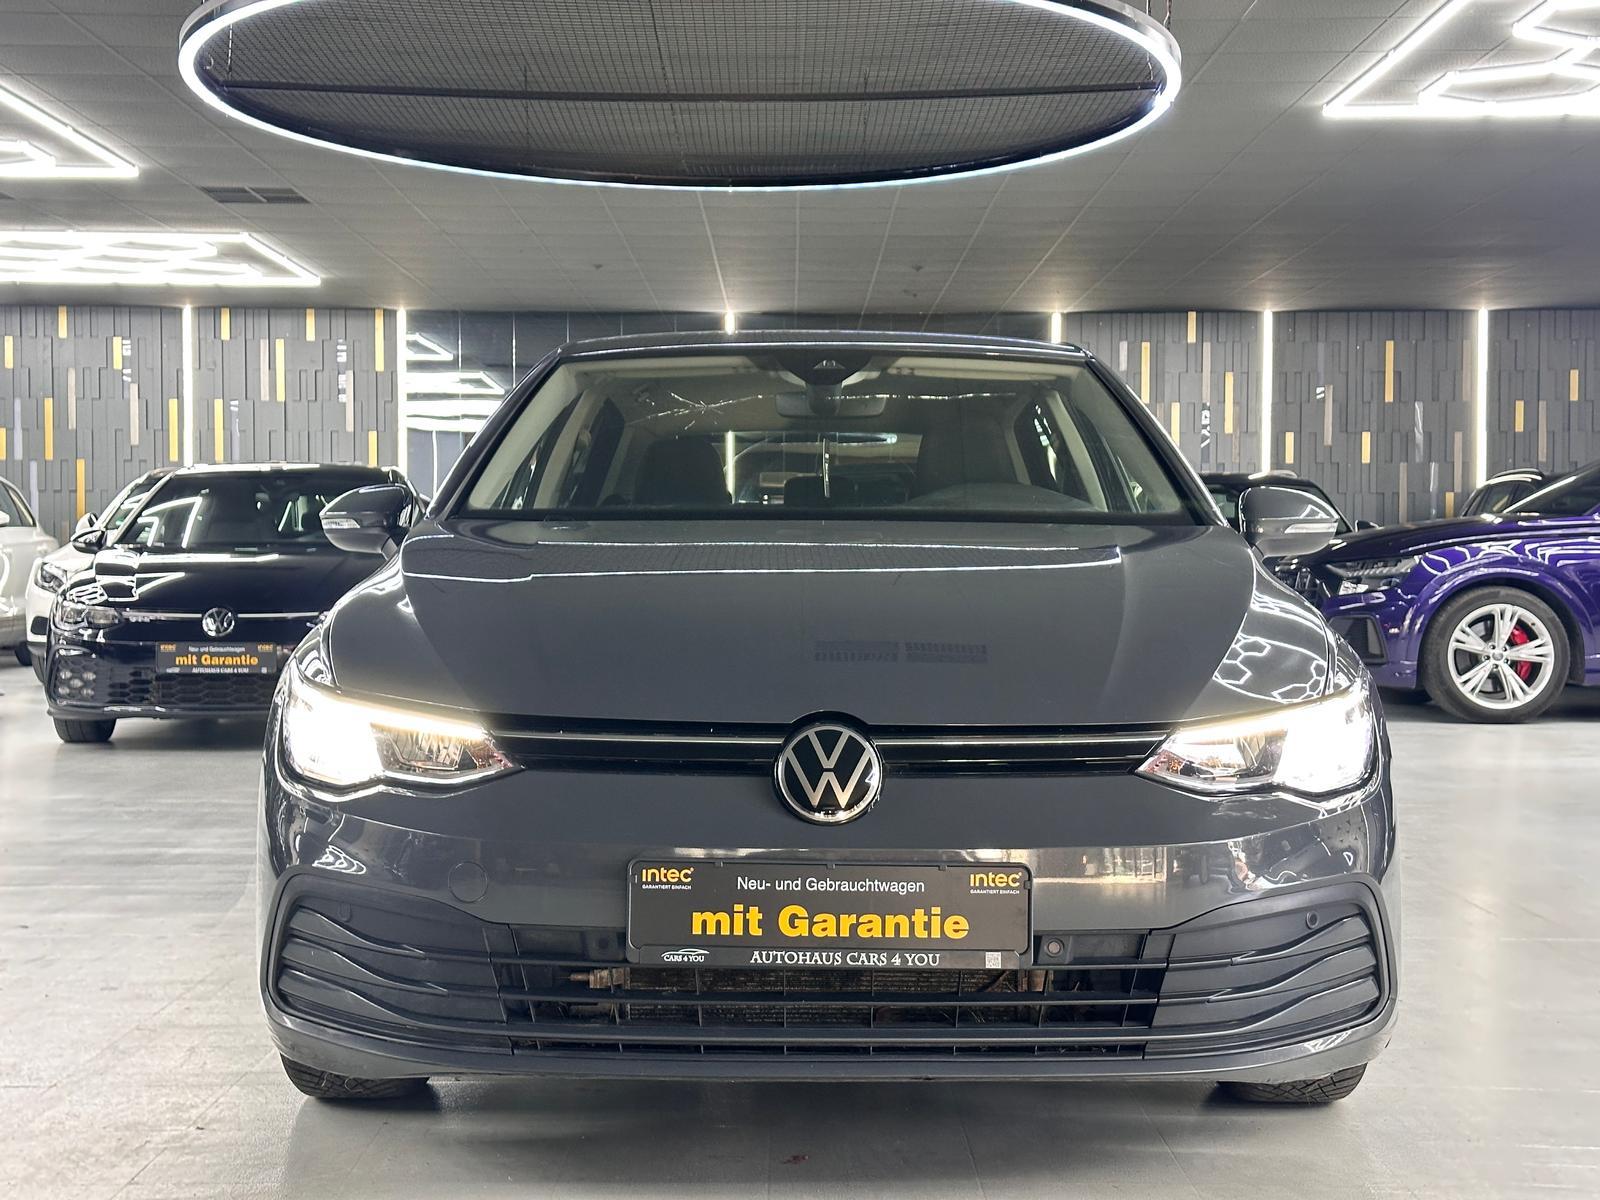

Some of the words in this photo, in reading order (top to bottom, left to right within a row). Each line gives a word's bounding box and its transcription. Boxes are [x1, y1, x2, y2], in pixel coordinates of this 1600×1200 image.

[642, 867, 693, 883] intec
[970, 872, 1021, 887] intec
[737, 877, 771, 890] Neu-
[775, 878, 801, 891] und
[806, 878, 925, 895] Gebrauchtwagen
[691, 904, 763, 936] mit
[777, 904, 970, 940] Garantie
[663, 954, 683, 963] CARS
[688, 955, 705, 963] YOU
[750, 951, 842, 966] AUTOHAUS
[846, 952, 887, 967] CARS
[891, 953, 901, 966] 4
[902, 953, 940, 967] YOU
